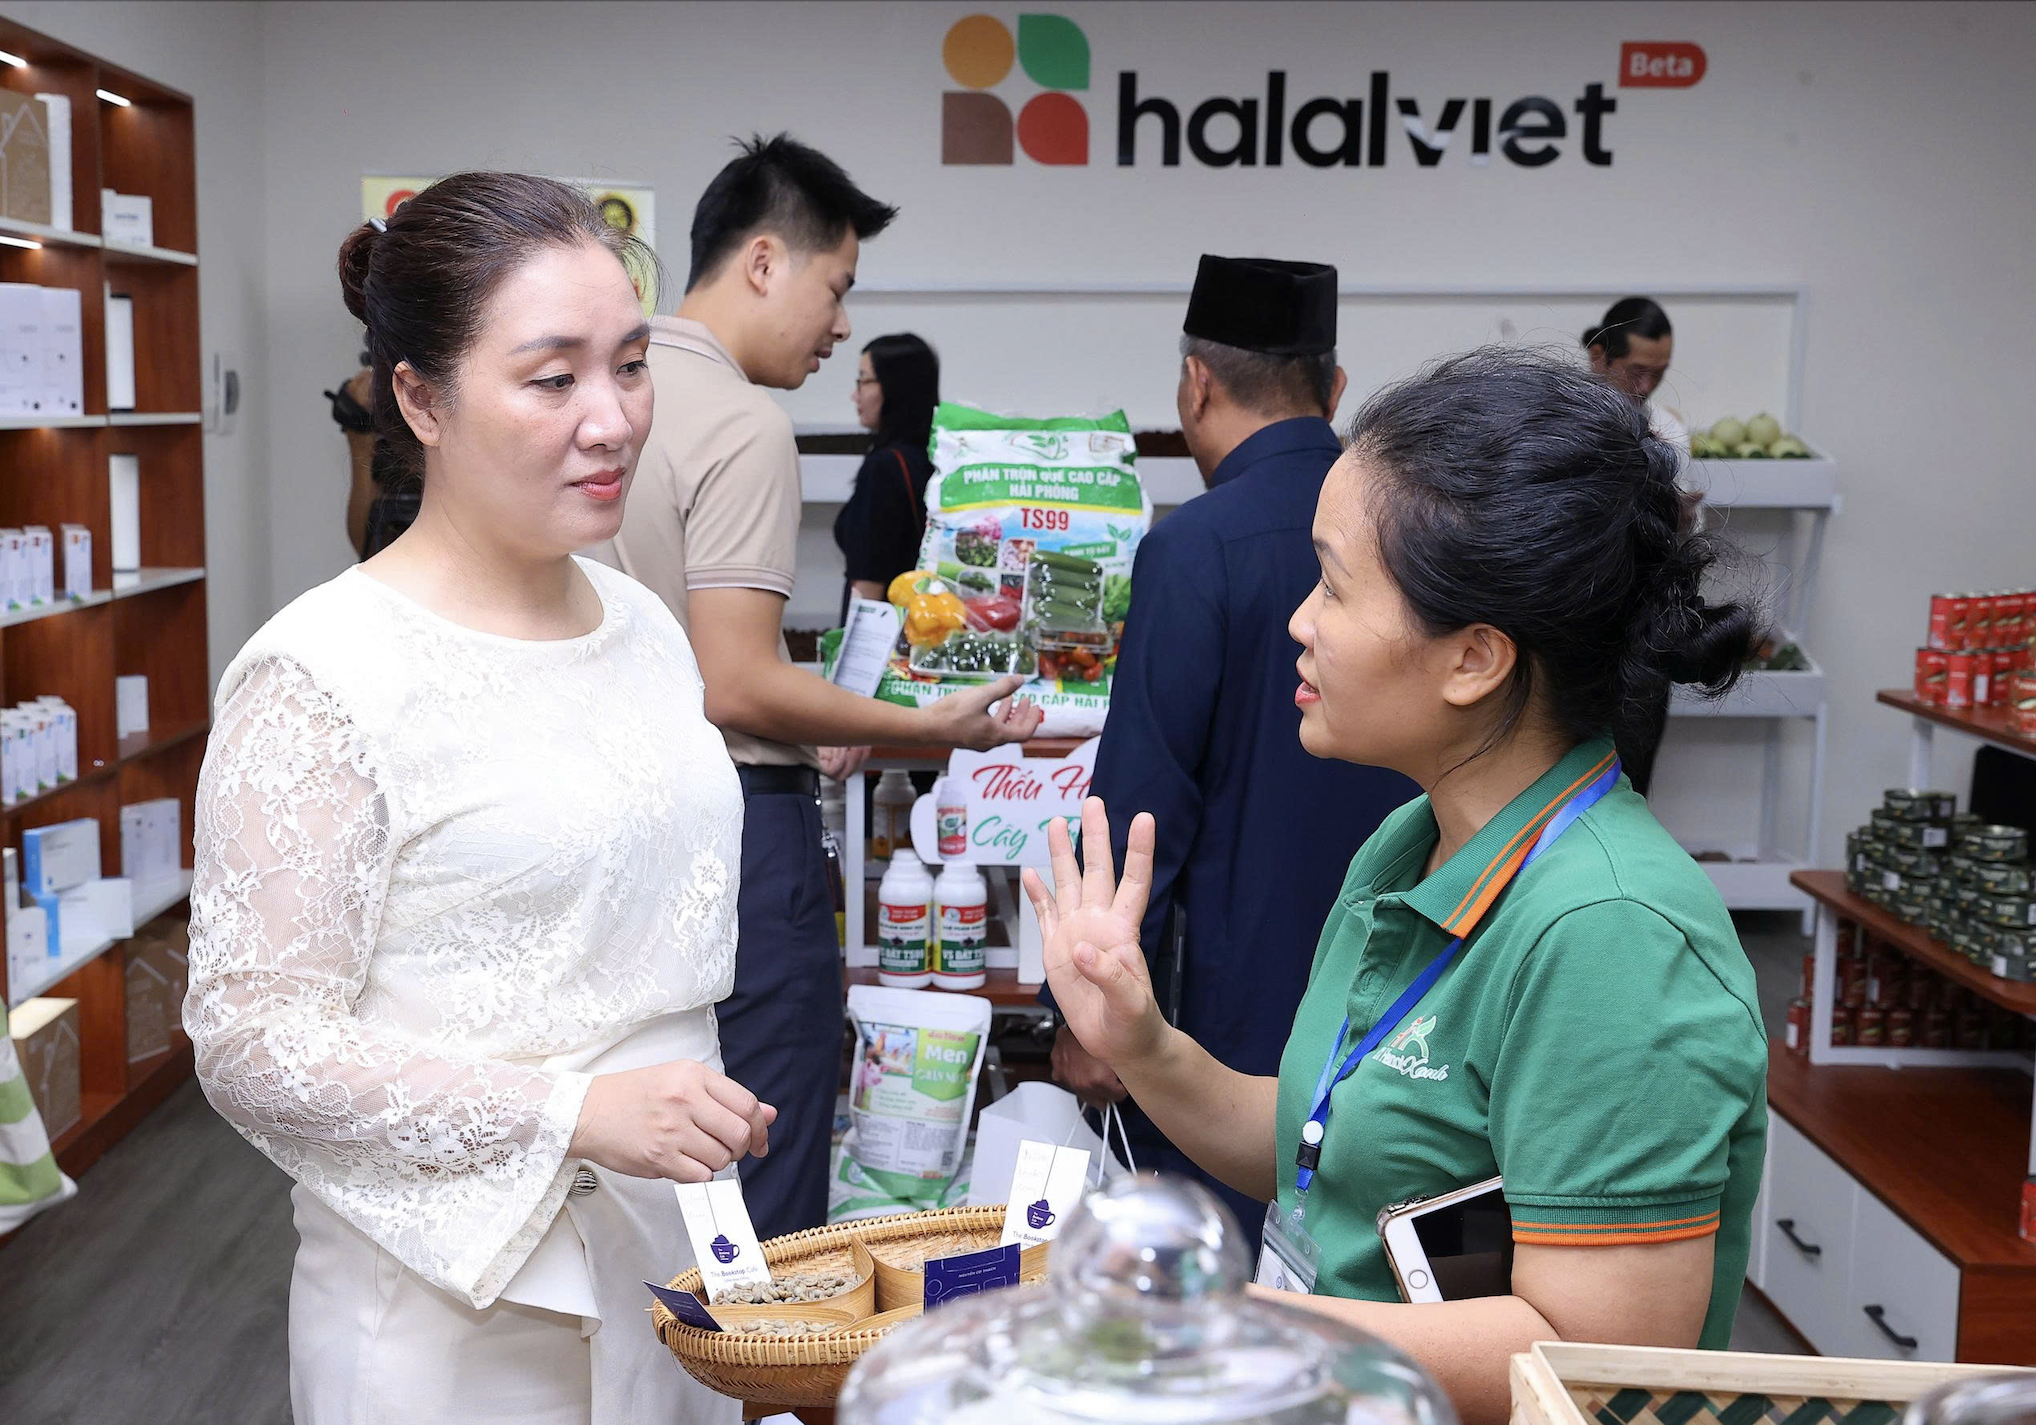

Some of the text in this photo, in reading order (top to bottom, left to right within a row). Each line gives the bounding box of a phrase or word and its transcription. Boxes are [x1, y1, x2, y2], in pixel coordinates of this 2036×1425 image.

[1629, 51, 1694, 77] Beta
[1116, 70, 1618, 168] halalviet
[963, 467, 1000, 485] PHÂN
[1068, 471, 1094, 485] CAO
[1020, 507, 1070, 531] TS99
[972, 764, 1043, 801] Thấu
[972, 815, 1029, 861] Cây
[924, 1044, 968, 1065] Men
